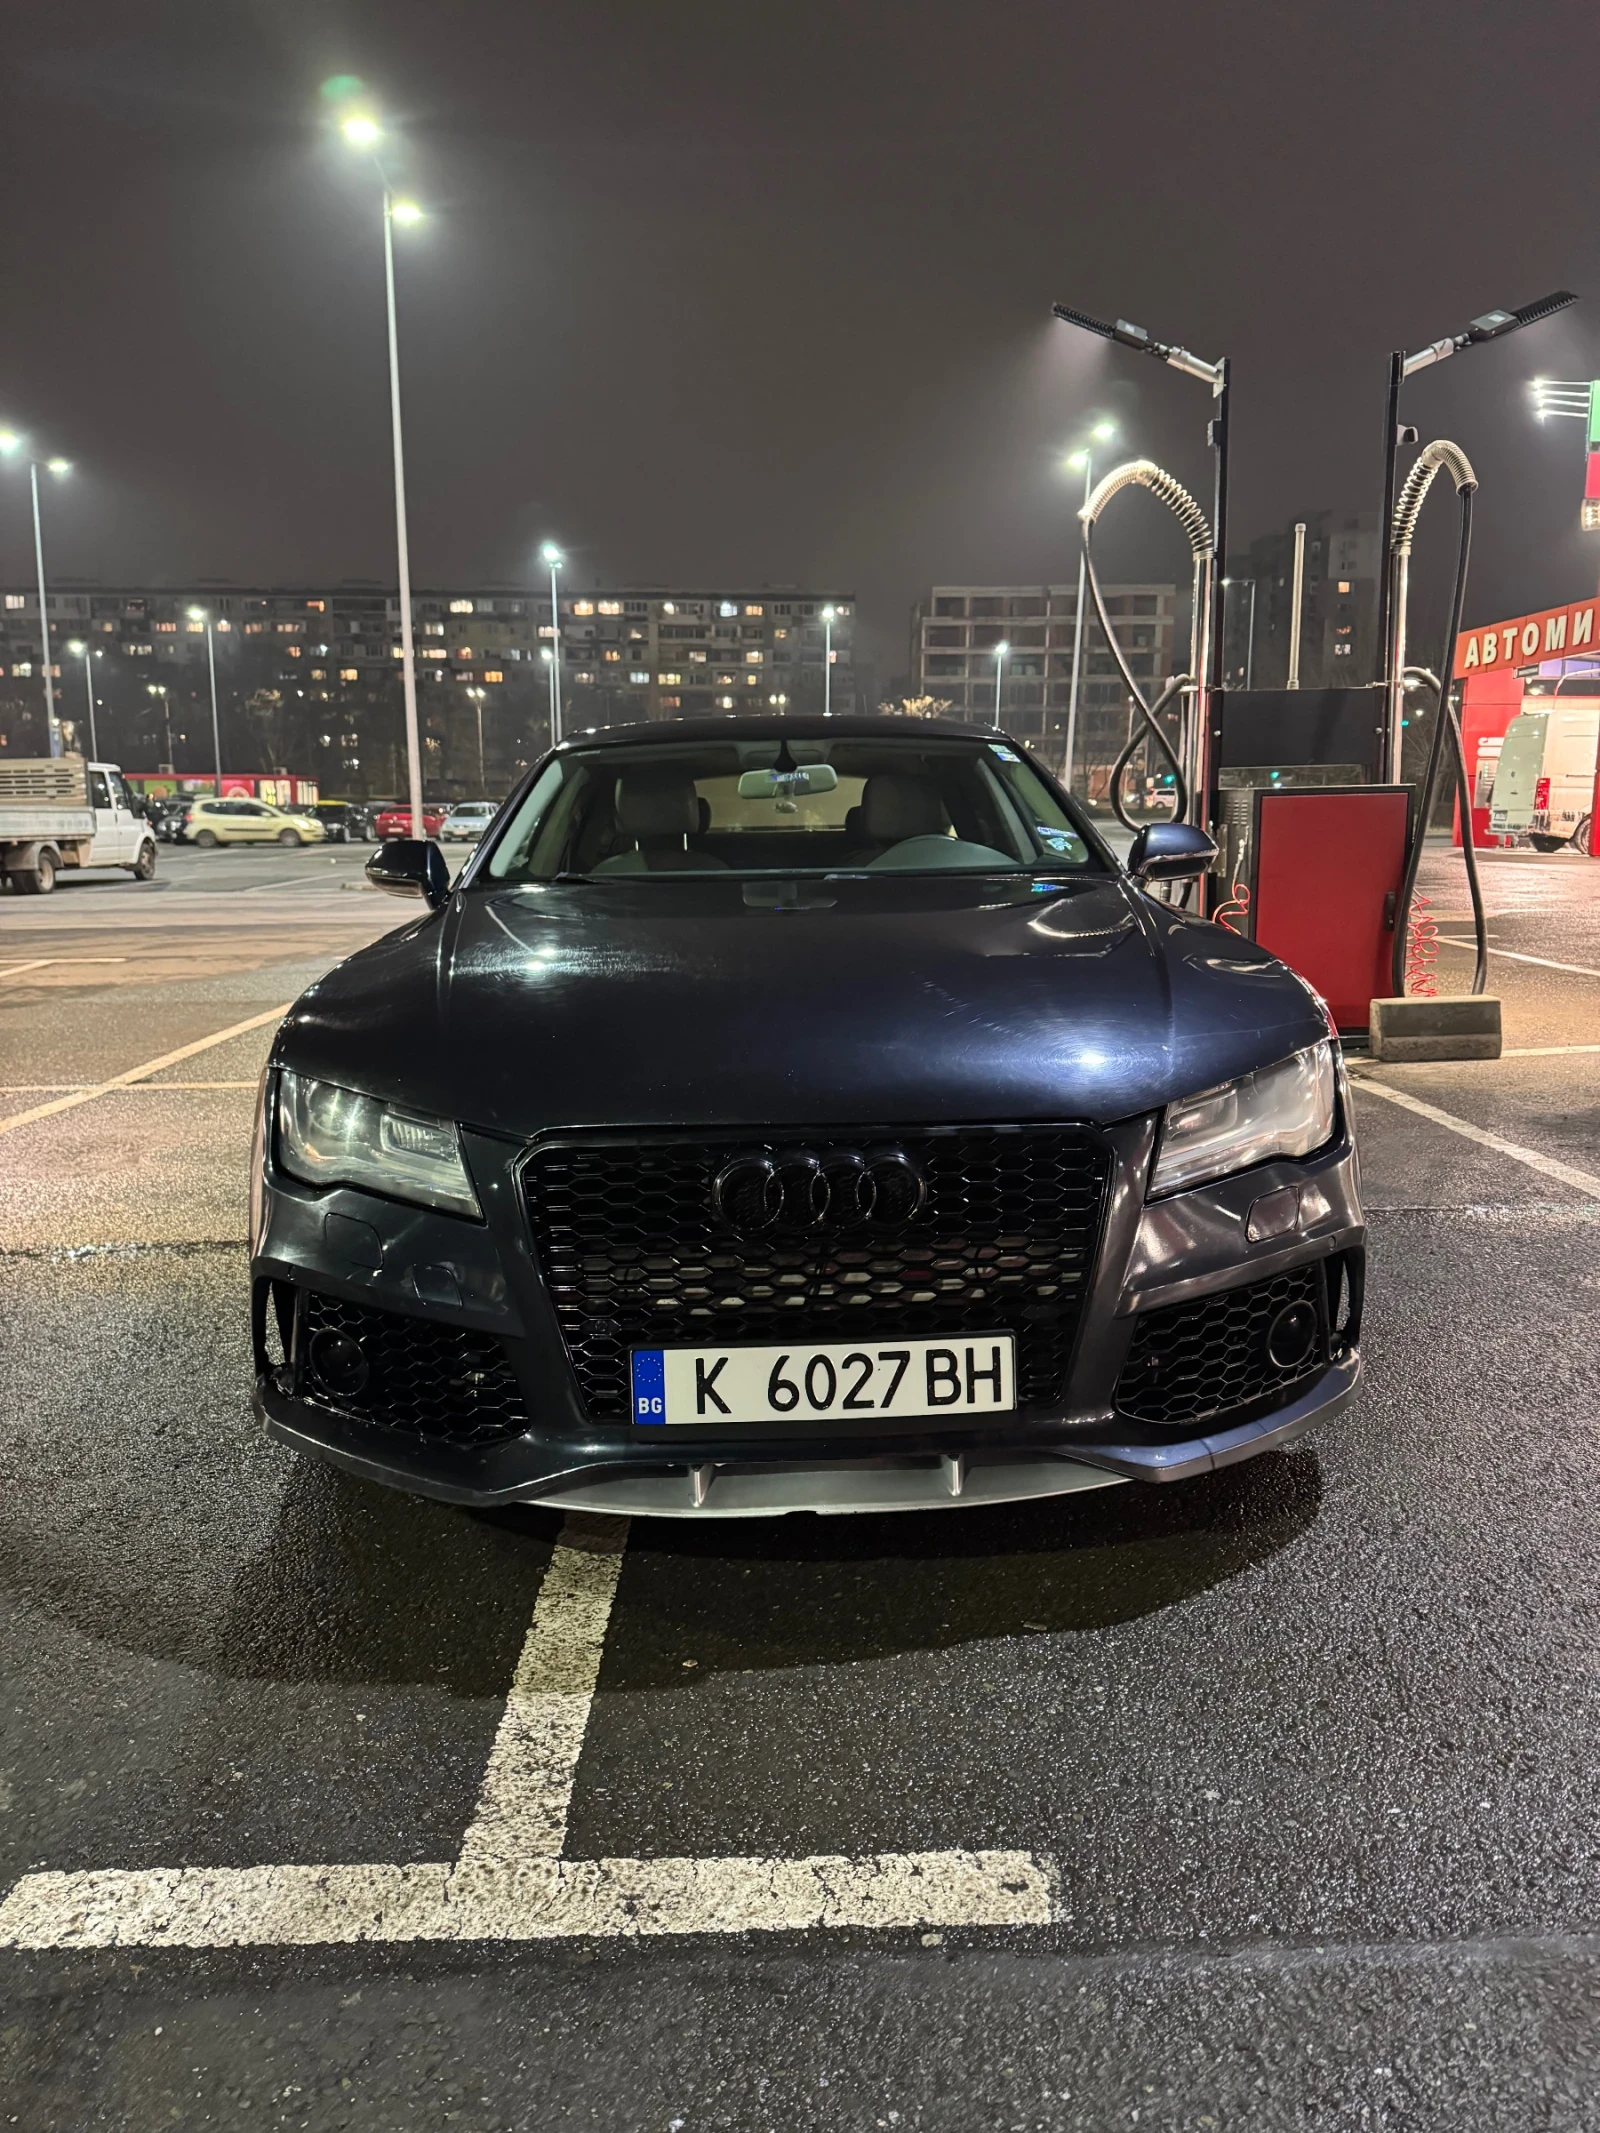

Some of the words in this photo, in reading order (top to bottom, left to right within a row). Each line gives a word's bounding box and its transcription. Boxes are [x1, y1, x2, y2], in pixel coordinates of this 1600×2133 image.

[1464, 608, 1600, 668] АВТОМИ
[638, 1397, 663, 1414] BG
[695, 1357, 732, 1415] K
[767, 1350, 911, 1412] 6027
[925, 1346, 1002, 1407] BH
